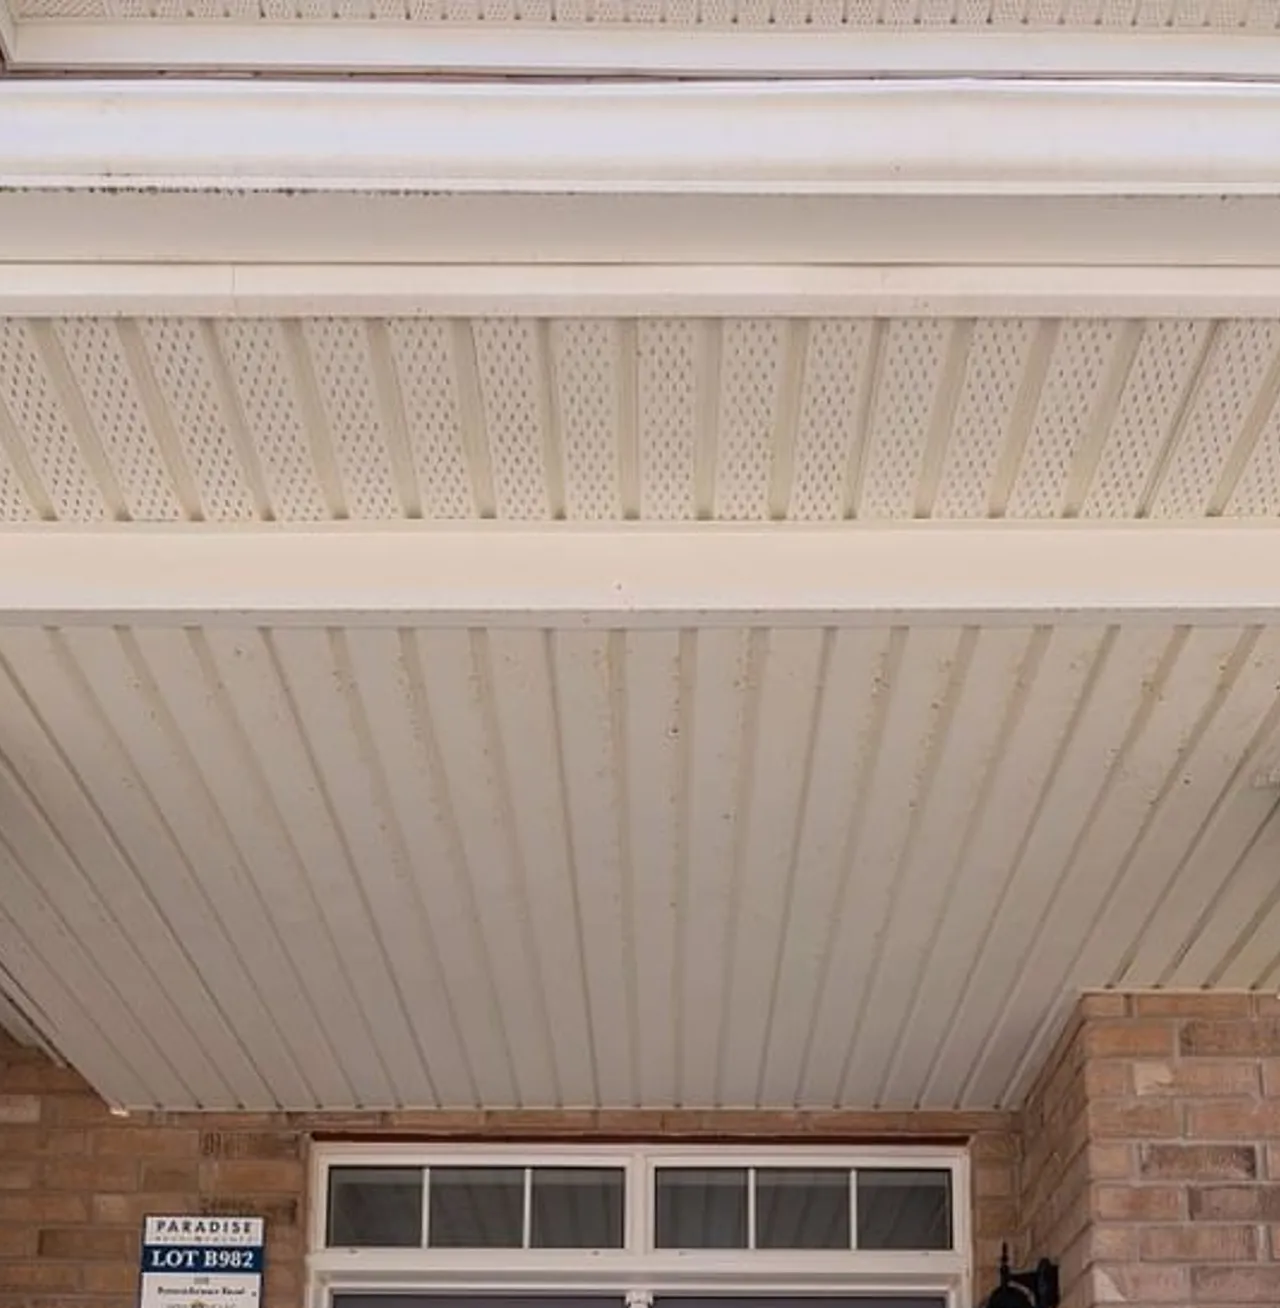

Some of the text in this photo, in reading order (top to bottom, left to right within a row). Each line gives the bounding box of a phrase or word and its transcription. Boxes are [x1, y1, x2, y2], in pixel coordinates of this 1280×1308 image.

[156, 1220, 252, 1234] PARADISE
[151, 1249, 254, 1268] LOT B982
